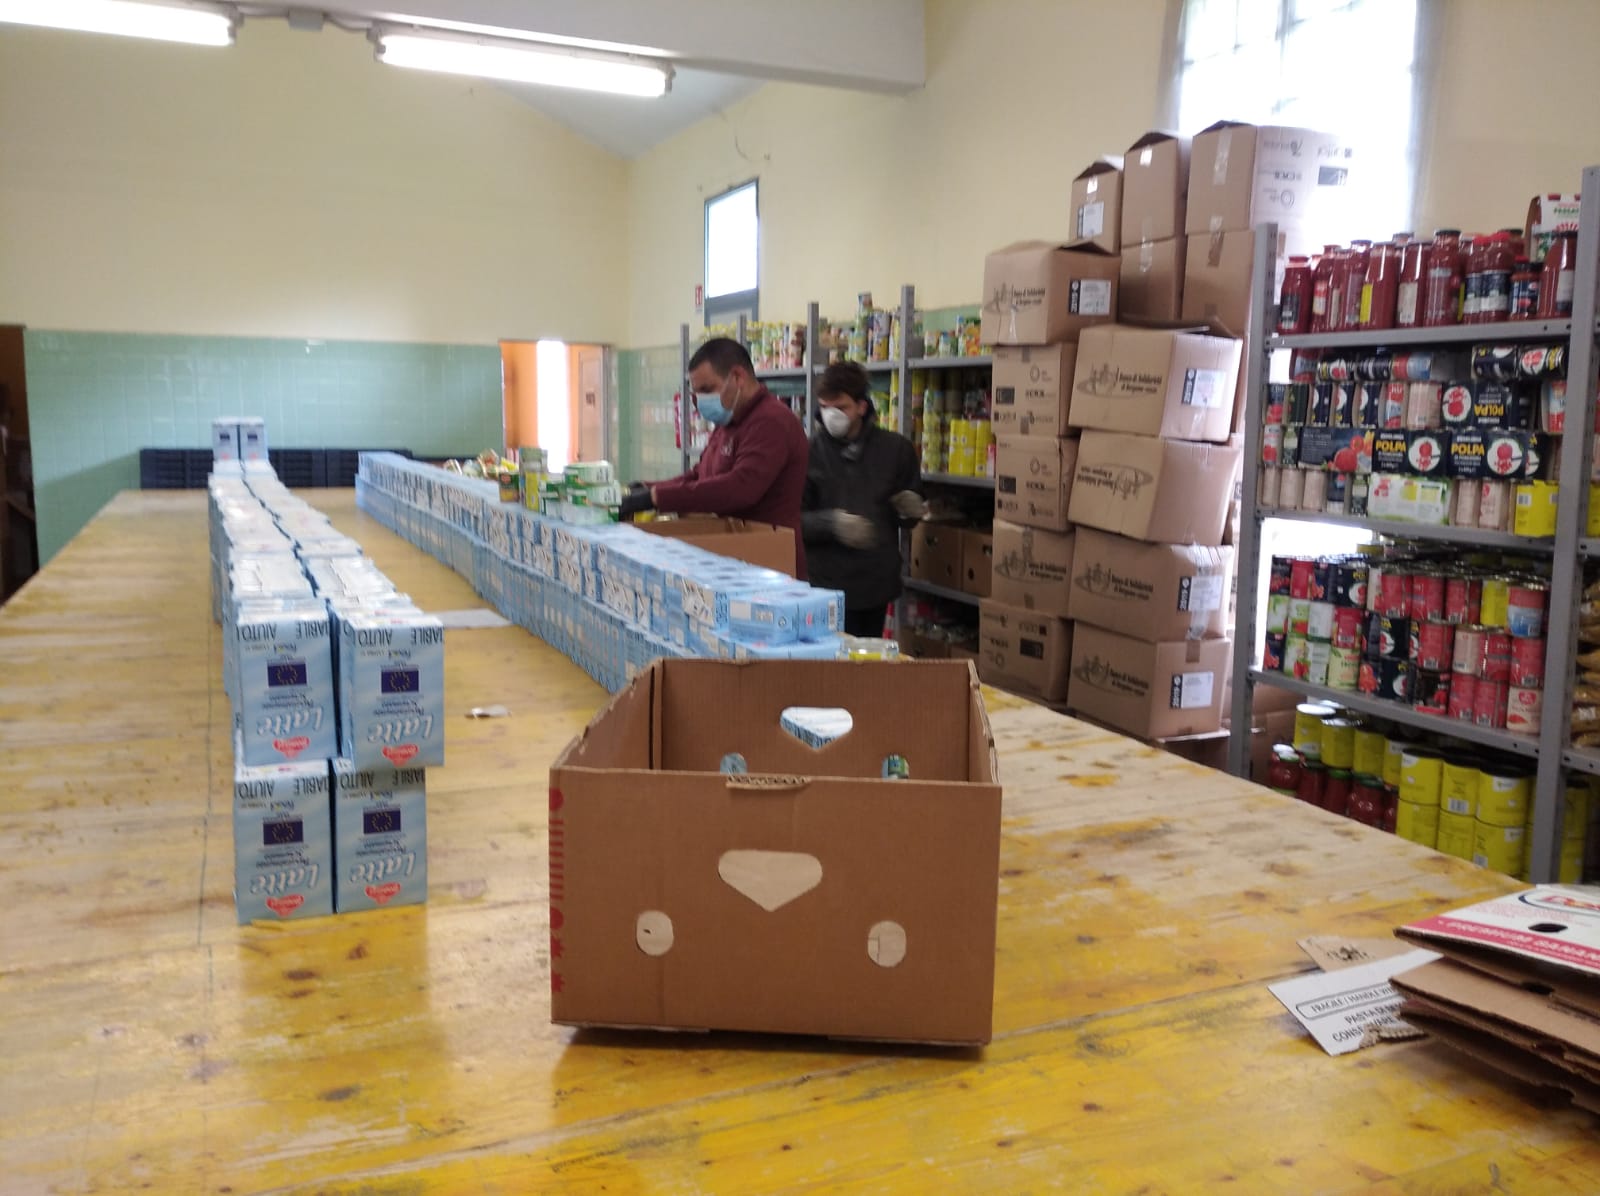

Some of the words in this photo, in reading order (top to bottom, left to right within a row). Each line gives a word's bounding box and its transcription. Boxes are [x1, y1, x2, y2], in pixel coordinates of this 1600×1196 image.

[1474, 403, 1504, 416] POLPA
[1375, 440, 1406, 453] POLPA
[1451, 442, 1485, 457] POLPA
[242, 624, 277, 641] AIUTO
[358, 629, 393, 647] AIUTO
[256, 707, 323, 737] Latte
[367, 714, 434, 743] Latte
[340, 771, 375, 789] AIUTO
[238, 780, 275, 799] AIUTO
[350, 851, 416, 882] Latte
[250, 863, 320, 895] Latte
[1446, 920, 1533, 943] PREMIUM
[1310, 998, 1343, 1014] FRAGILE
